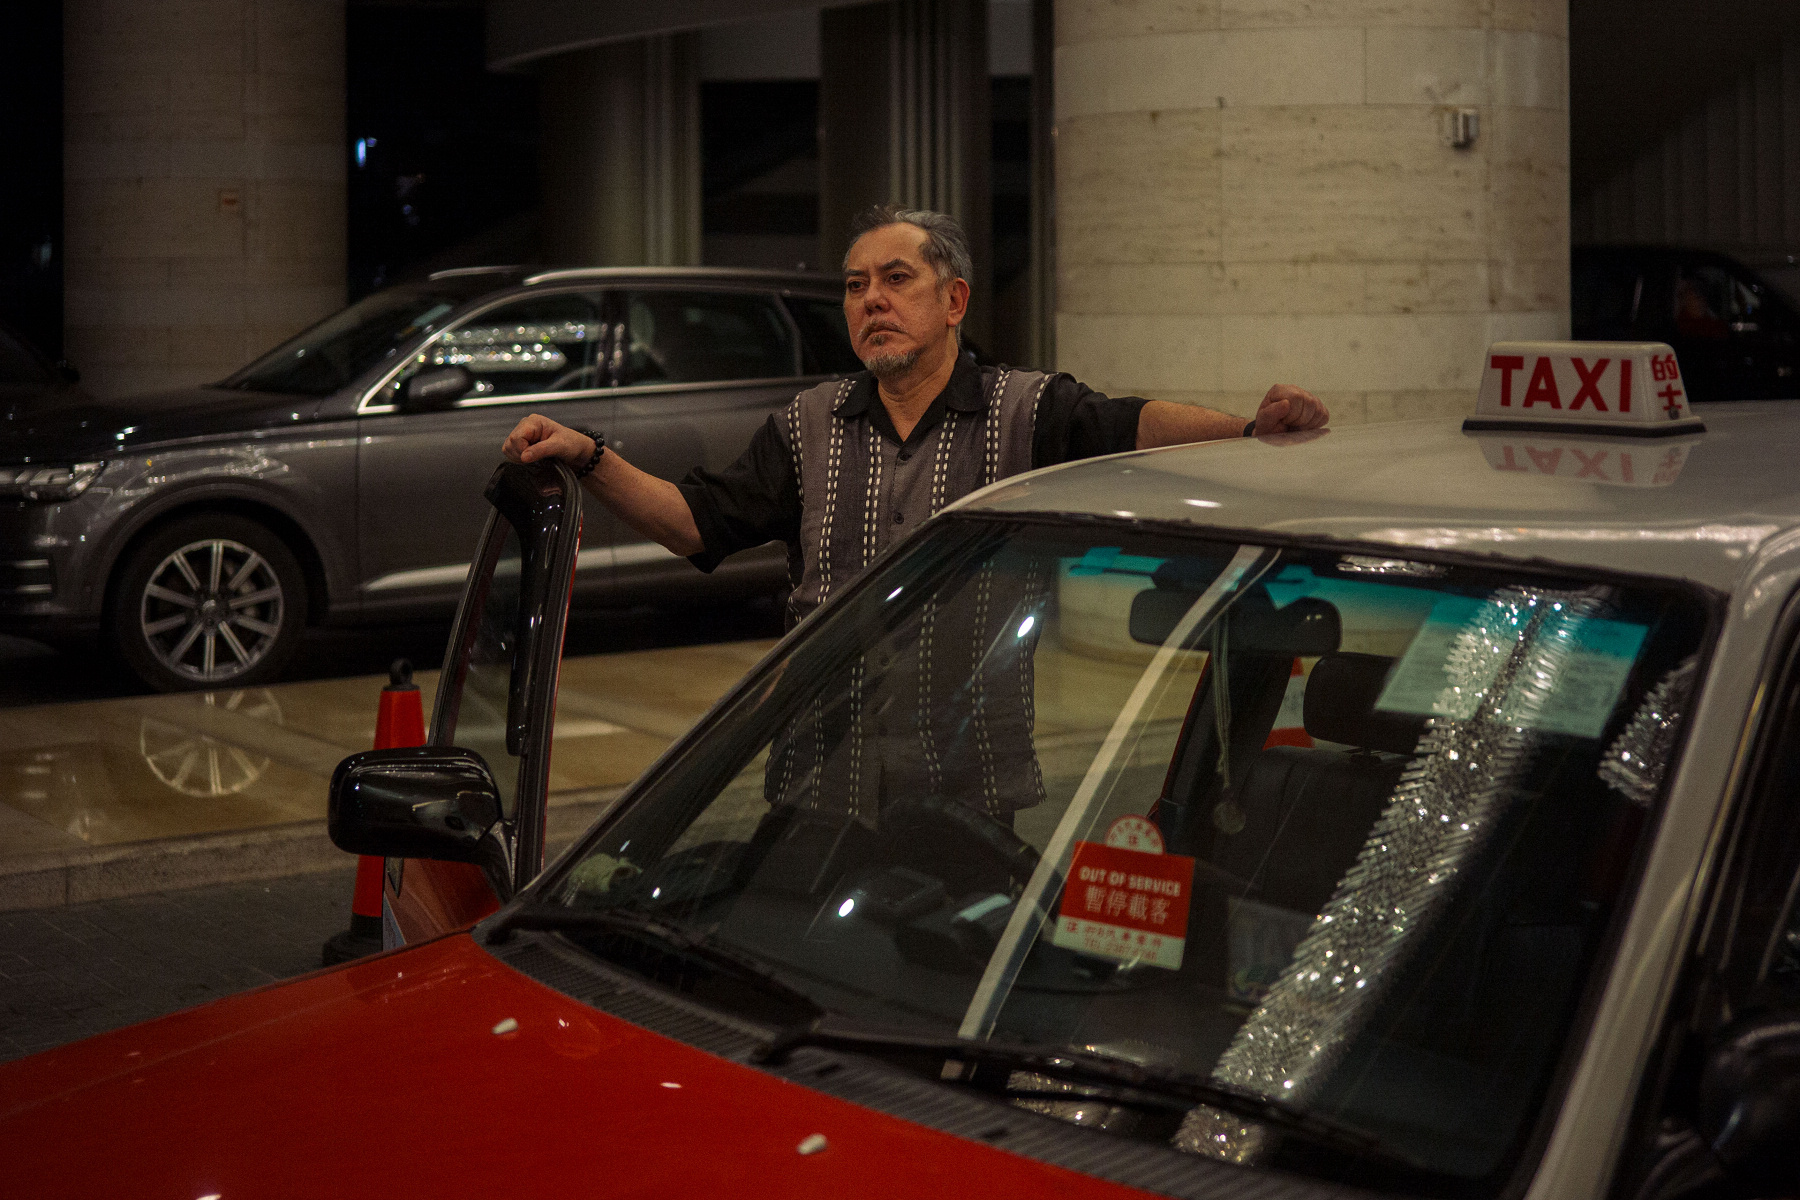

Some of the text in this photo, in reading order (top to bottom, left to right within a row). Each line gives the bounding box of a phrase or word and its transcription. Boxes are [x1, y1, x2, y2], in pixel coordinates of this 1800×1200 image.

[1491, 355, 1632, 412] TAXI
[1651, 354, 1684, 412] 的士
[1080, 865, 1181, 897] OUT OF SERVICE
[1084, 884, 1171, 925] 暫停載客
